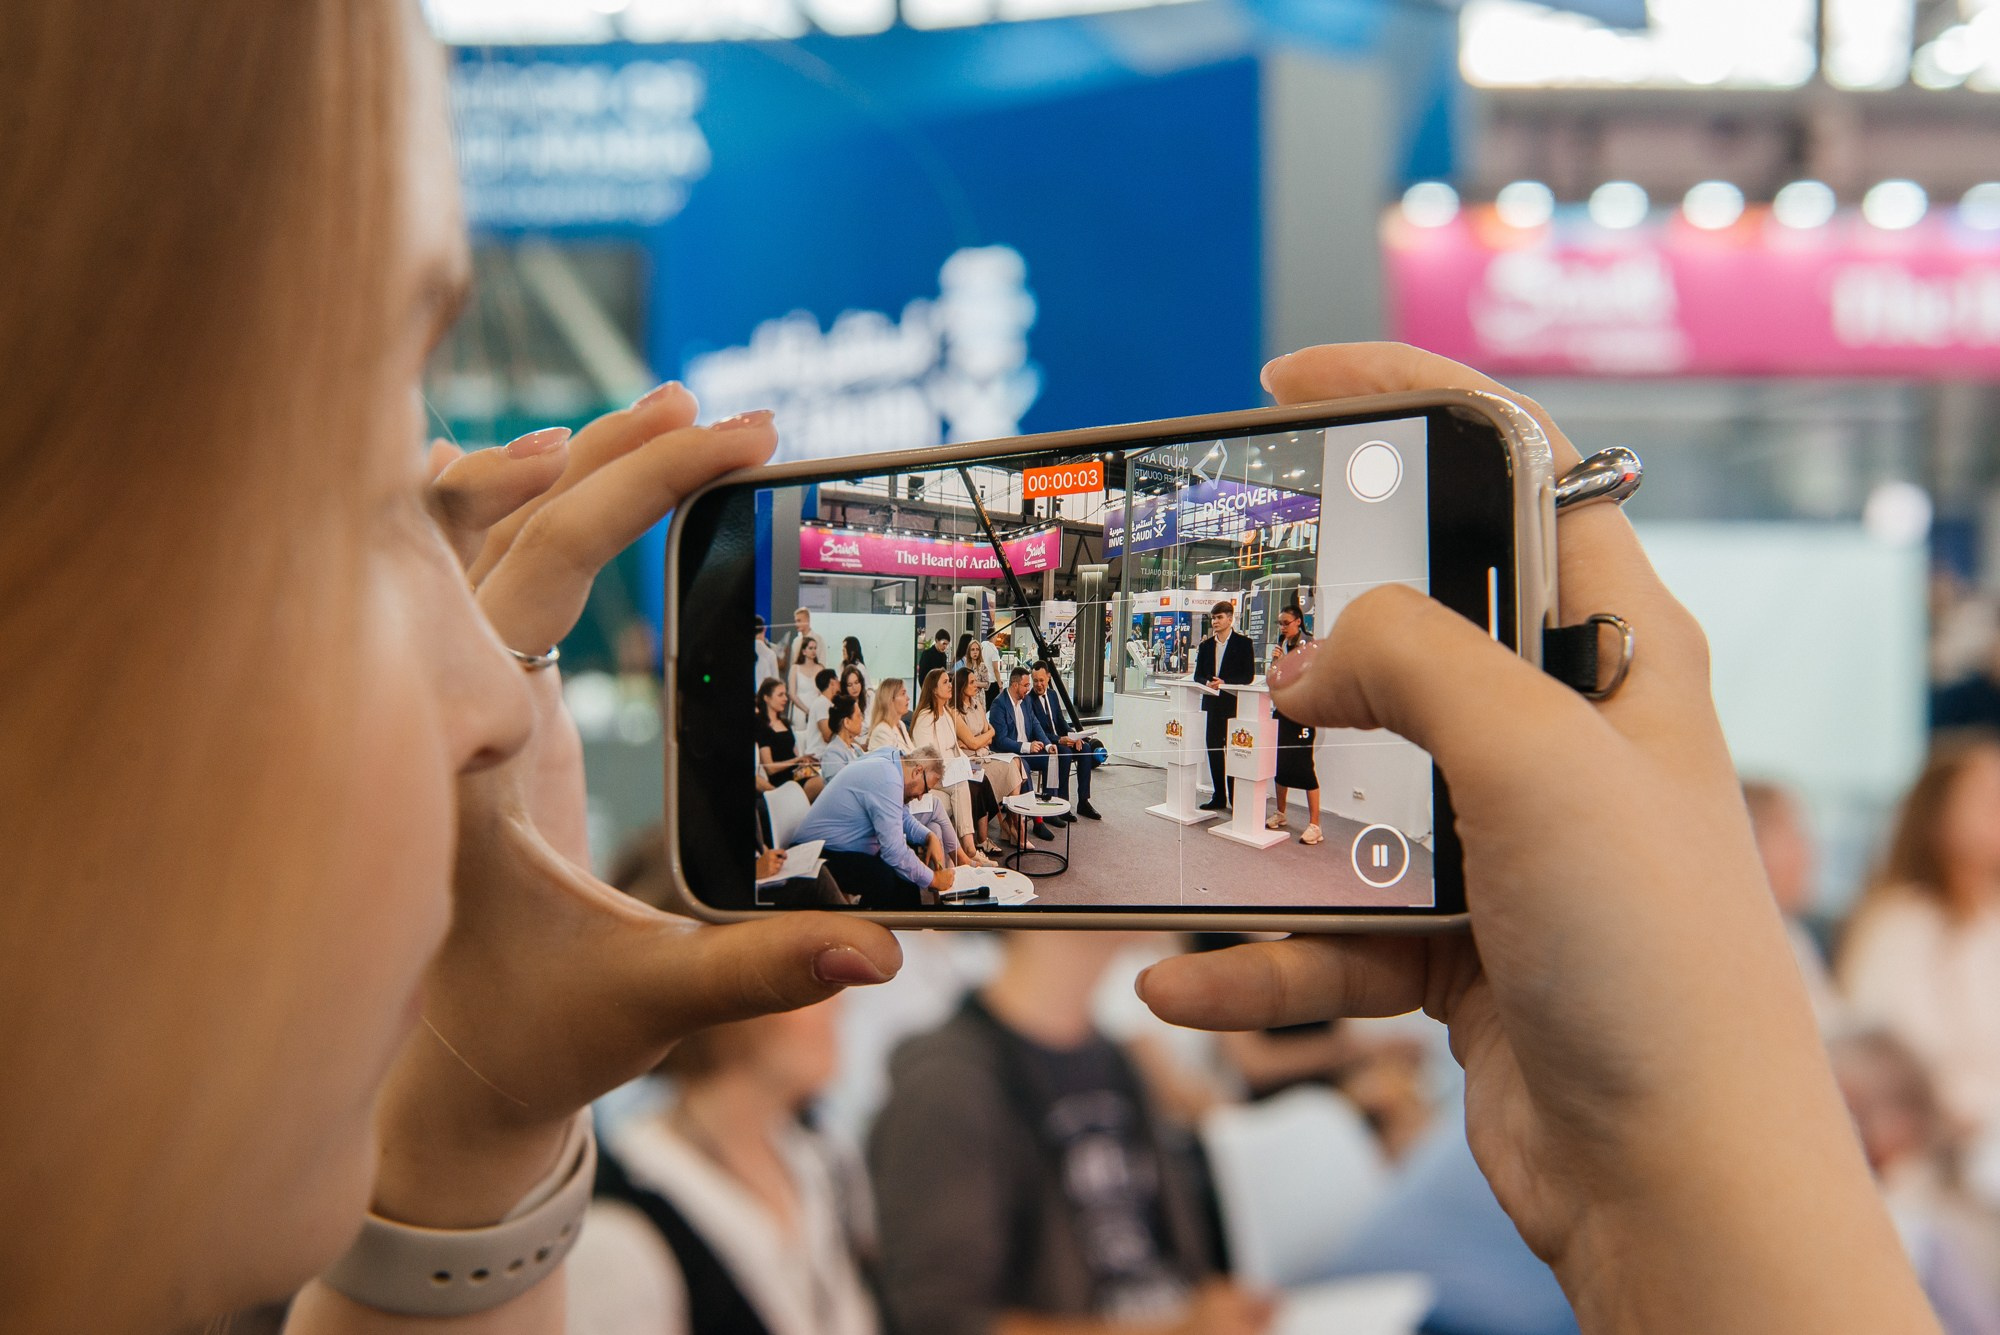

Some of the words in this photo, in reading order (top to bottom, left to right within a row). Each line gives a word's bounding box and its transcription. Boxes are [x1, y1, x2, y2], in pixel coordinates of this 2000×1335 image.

[1028, 469, 1099, 492] 00:00:03
[1203, 487, 1278, 515] DISCOVER
[1108, 535, 1125, 548] INVE
[1131, 529, 1153, 543] SAUDI
[895, 550, 919, 565] The
[921, 552, 954, 568] Heart
[955, 555, 969, 569] of
[1299, 595, 1306, 606] 5
[1298, 727, 1310, 739] .5
